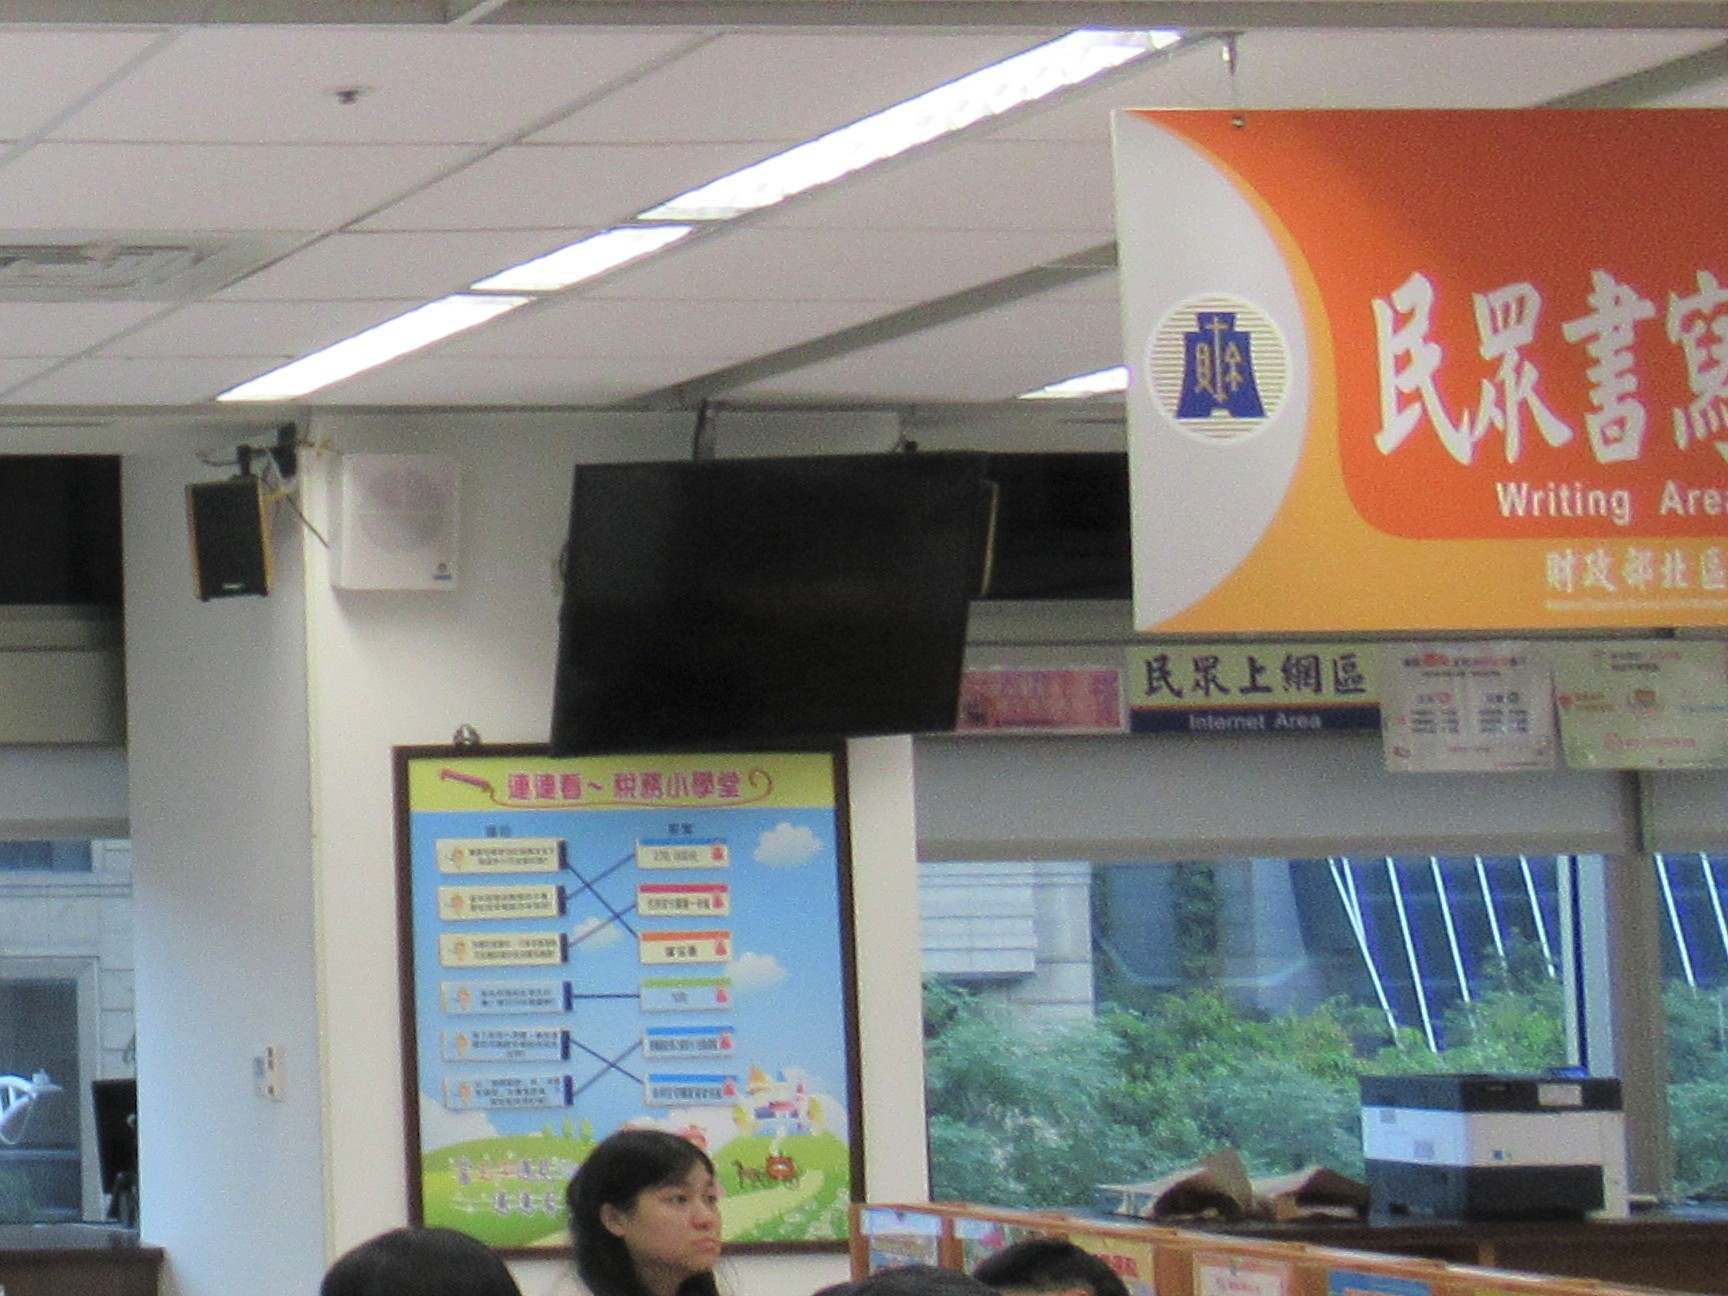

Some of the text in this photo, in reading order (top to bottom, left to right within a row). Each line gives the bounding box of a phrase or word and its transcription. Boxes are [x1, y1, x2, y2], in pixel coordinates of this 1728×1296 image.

[1495, 478, 1728, 527] Writing Are
[1188, 709, 1322, 732] Internet Area
